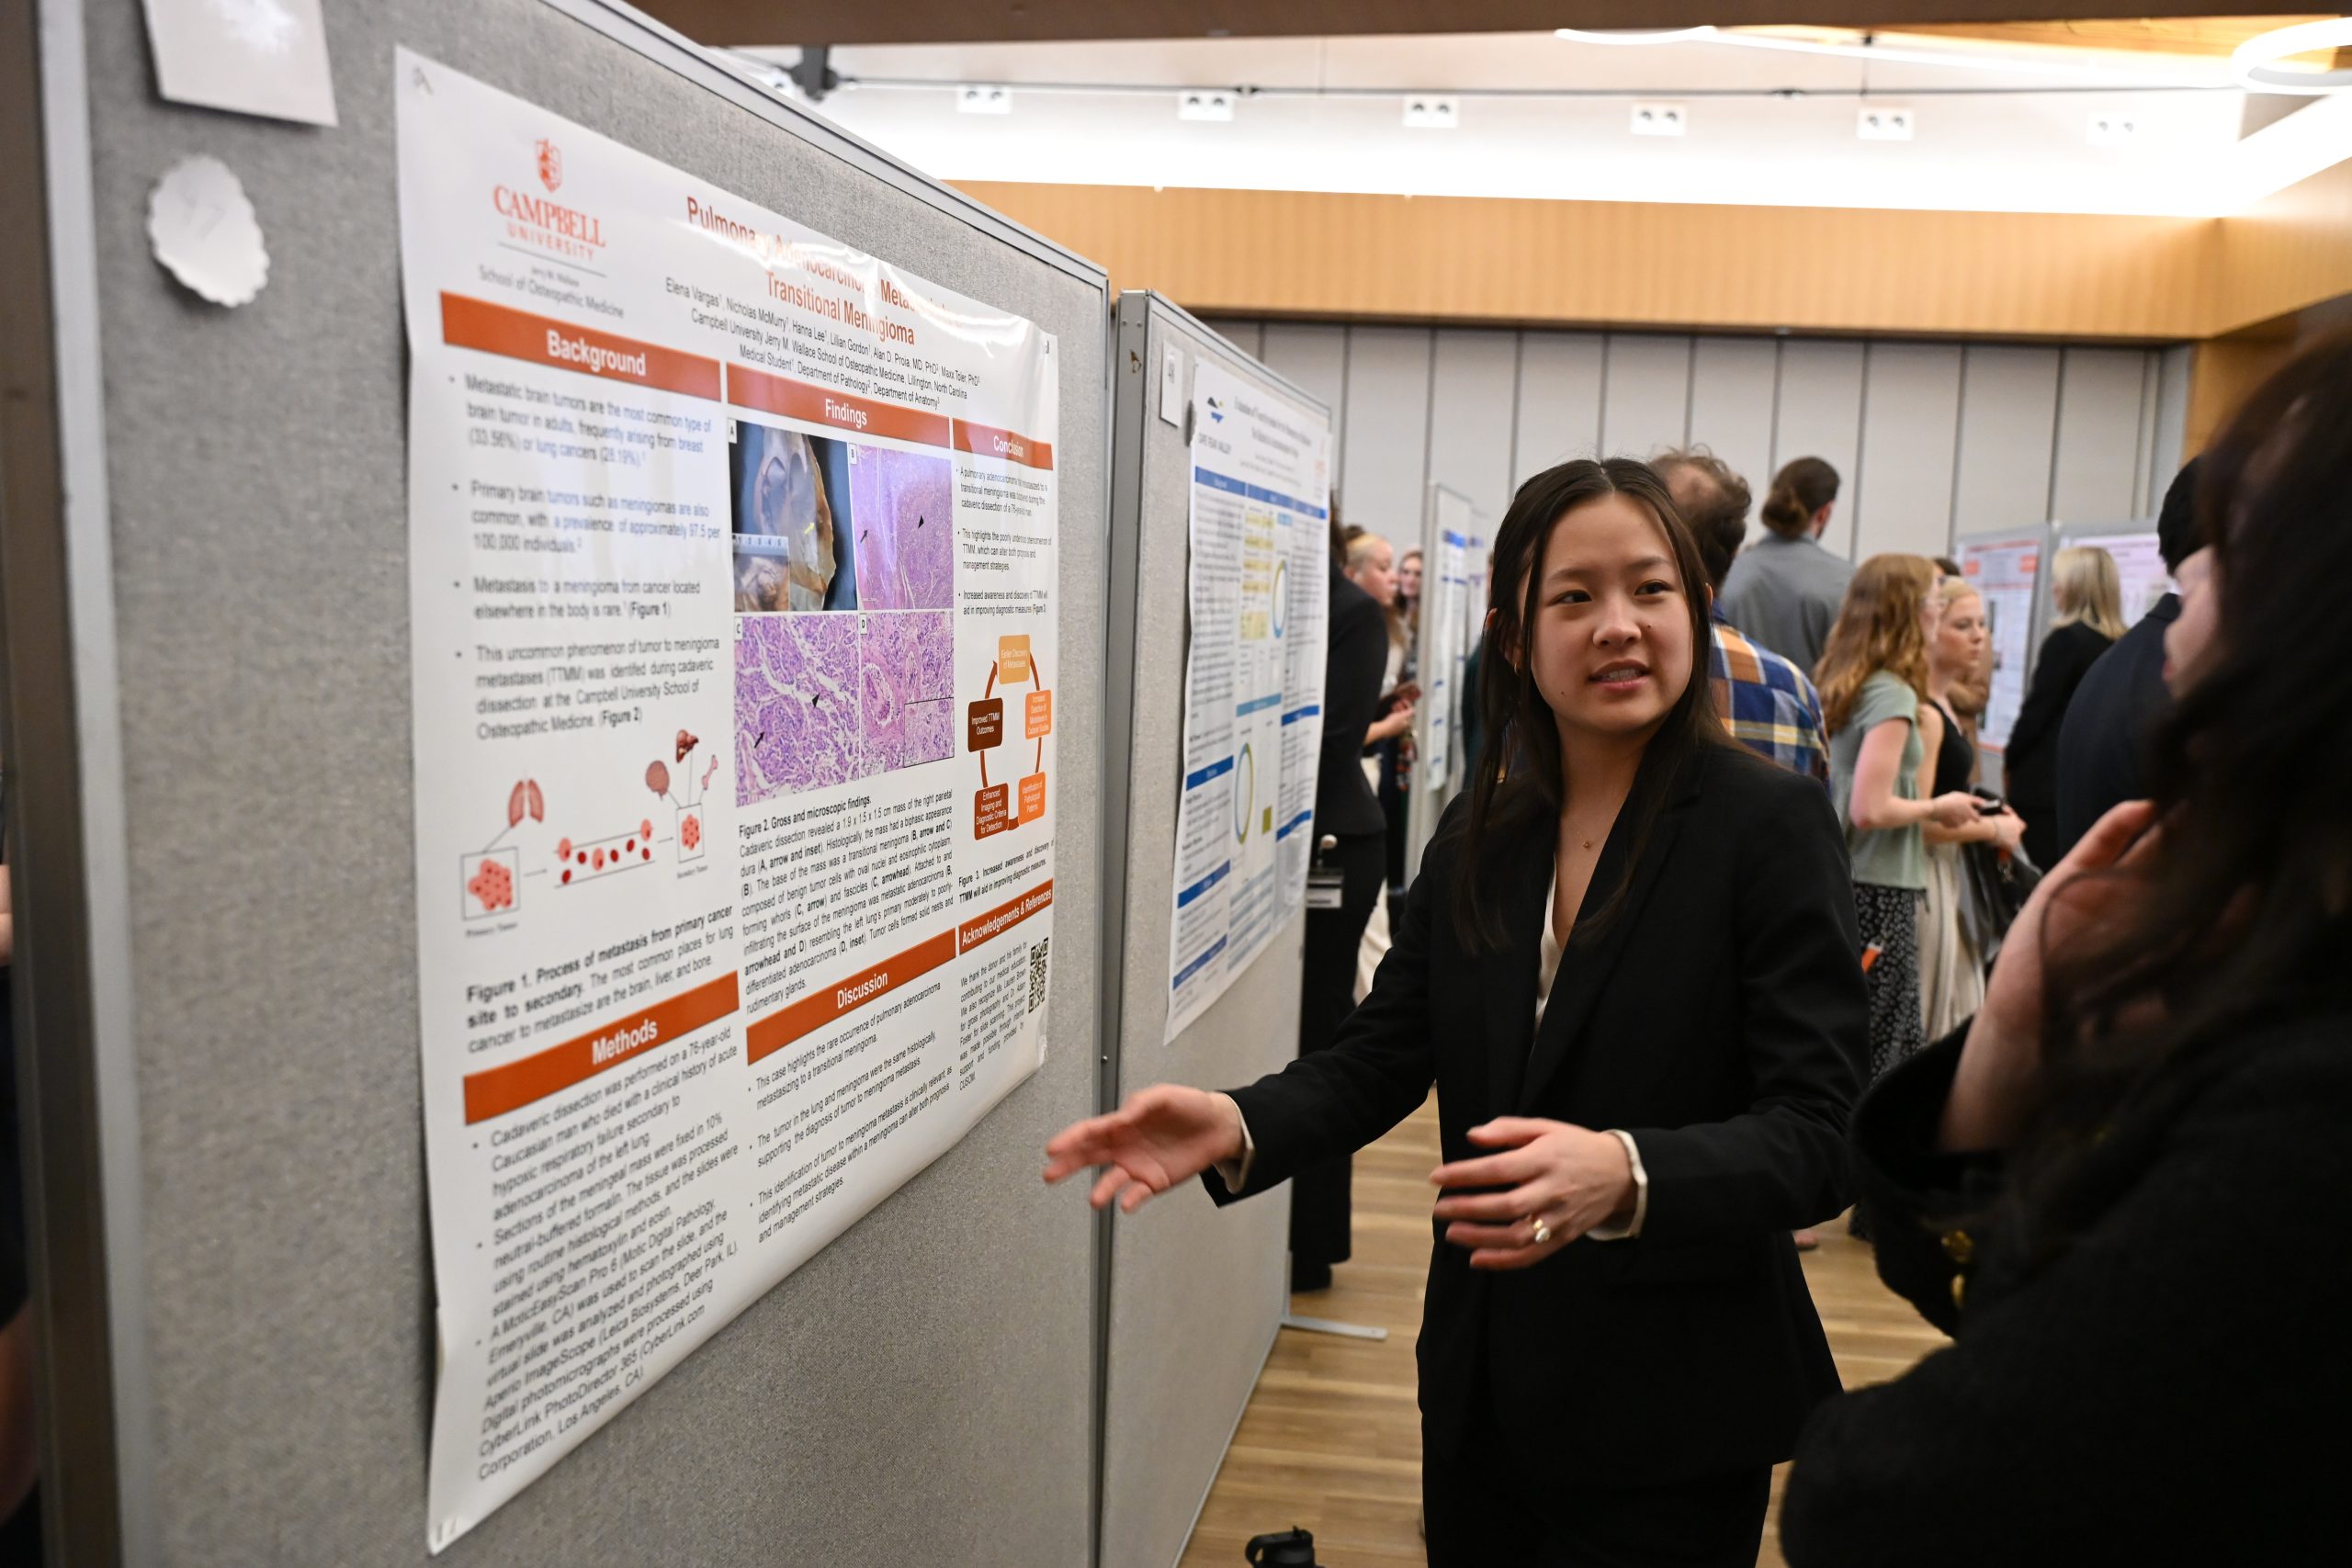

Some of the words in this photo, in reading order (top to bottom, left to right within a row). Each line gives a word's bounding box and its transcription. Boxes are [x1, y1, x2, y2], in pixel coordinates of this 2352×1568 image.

[493, 186, 606, 247] CAMPBELL
[508, 224, 594, 261] UNIVERSITY
[479, 265, 514, 284] School
[585, 295, 624, 318] Medicine
[765, 269, 841, 321] Transitional
[844, 300, 914, 345] Meningioma
[666, 276, 689, 294] Elena
[727, 298, 756, 320] Nicholas
[793, 323, 811, 337] Hanna
[874, 347, 886, 361] Alan
[942, 367, 955, 379] Maxx
[547, 330, 646, 376] Background
[692, 308, 728, 331] Campbell
[730, 323, 763, 344] University
[765, 333, 780, 347] Jerry
[793, 340, 815, 358] Wallace
[818, 351, 837, 367] School
[839, 355, 843, 367] of
[845, 357, 877, 377] Osteopathic
[879, 367, 906, 384] Medicine,
[934, 382, 947, 394] North
[949, 385, 967, 400] Carolina
[465, 373, 523, 399] Metastatic
[526, 388, 549, 404] brain
[552, 393, 586, 412] tumors
[647, 411, 683, 428] common
[685, 415, 702, 433] type
[826, 399, 866, 428] Findings
[874, 382, 907, 400] Department
[579, 421, 623, 443] frequently
[627, 428, 654, 448] arising
[657, 433, 676, 448] from
[679, 436, 704, 453] breast
[994, 436, 1024, 457] Conclusion
[643, 581, 671, 593] cancer
[673, 580, 700, 593] located
[577, 687, 618, 706] Campbell
[621, 683, 661, 699] University
[663, 680, 689, 696] School
[972, 715, 988, 726] Improved
[977, 725, 994, 735] Outcomes
[739, 821, 762, 838] Figure
[763, 820, 768, 832] 2.
[772, 814, 791, 828] Gross
[793, 810, 805, 823] and
[808, 800, 846, 820] microscopic
[848, 795, 871, 811] findings.
[977, 812, 994, 825] Diagnostic
[995, 810, 1007, 820] Criteria
[981, 802, 995, 813] Imaging
[983, 790, 1001, 801] Enhanced
[740, 839, 773, 858] Cadaveric
[775, 828, 805, 846] dissection
[808, 821, 834, 838] revealed
[843, 815, 852, 827] 1.9
[874, 807, 882, 818] 1.5
[893, 803, 906, 814] mass
[922, 795, 933, 807] right
[936, 790, 953, 805] parietal
[741, 864, 756, 878] dura
[770, 855, 788, 868] arrow
[790, 849, 803, 862] and
[826, 833, 863, 851] Histologically,
[865, 828, 873, 839] the
[875, 824, 888, 835] mass
[904, 815, 923, 829] biphasic
[926, 806, 953, 822] appearance
[987, 820, 1002, 832] Detection
[757, 878, 769, 891] The
[773, 873, 787, 886] base
[798, 865, 808, 877] the
[810, 861, 826, 873] mass
[829, 858, 841, 868] was
[848, 845, 877, 861] transitional
[879, 835, 910, 849] meningioma
[920, 828, 934, 838] arrow
[959, 874, 973, 887] Figure
[983, 862, 1002, 876] Increased
[1005, 854, 1023, 867] awareness
[1035, 842, 1049, 853] discovery
[960, 889, 973, 904] TTMM
[994, 874, 1012, 889] improving
[1013, 867, 1029, 880] diagnostic
[1030, 858, 1046, 870] measures.
[962, 905, 1020, 947] Acknowledgements
[1020, 899, 1024, 912] &
[1025, 888, 1052, 909] References
[467, 979, 514, 1003] Figure
[537, 962, 580, 985] Process
[585, 952, 595, 966] of
[598, 936, 648, 963] metastasis
[650, 924, 672, 942] from
[674, 916, 705, 938] primary
[707, 904, 732, 923] cancer
[590, 972, 607, 988] The
[612, 964, 634, 979] most
[638, 948, 673, 970] common
[678, 939, 702, 957] places
[719, 926, 733, 941] lung
[837, 973, 888, 1010] Discussion
[592, 1019, 658, 1066] Methods
[689, 1027, 731, 1055] 76-year-old
[756, 1075, 770, 1090] This
[772, 1068, 786, 1082] case
[787, 1052, 814, 1077] highlights
[816, 1043, 826, 1057] the
[827, 1037, 838, 1051] rare
[840, 1022, 869, 1043] occurrence
[877, 1002, 901, 1023] pulmonary
[904, 982, 941, 1010] adenocarcinoma
[682, 1062, 707, 1081] history
[718, 1046, 737, 1063] acute
[756, 1080, 799, 1111] metastasizing
[814, 1055, 843, 1076] transitional
[844, 1034, 877, 1056] meningioma.
[811, 1099, 823, 1117] lung
[824, 1093, 835, 1107] and
[837, 1073, 868, 1097] meningioma
[893, 1050, 906, 1065] same
[907, 1032, 935, 1054] histologically.
[806, 1111, 832, 1136] diagnosis
[841, 1096, 856, 1112] tumor
[864, 1074, 894, 1100] meningioma
[896, 1057, 921, 1080] metastasis.
[689, 1130, 729, 1163] processed
[775, 1161, 812, 1192] identification
[821, 1140, 836, 1159] tumor
[845, 1119, 876, 1145] meningioma
[878, 1095, 903, 1123] metastasis
[910, 1078, 928, 1100] clinically
[696, 1156, 718, 1176] slides
[720, 1144, 738, 1162] were
[676, 1199, 716, 1231] Pathology,
[774, 1196, 814, 1235] management
[816, 1176, 843, 1203] strategies.
